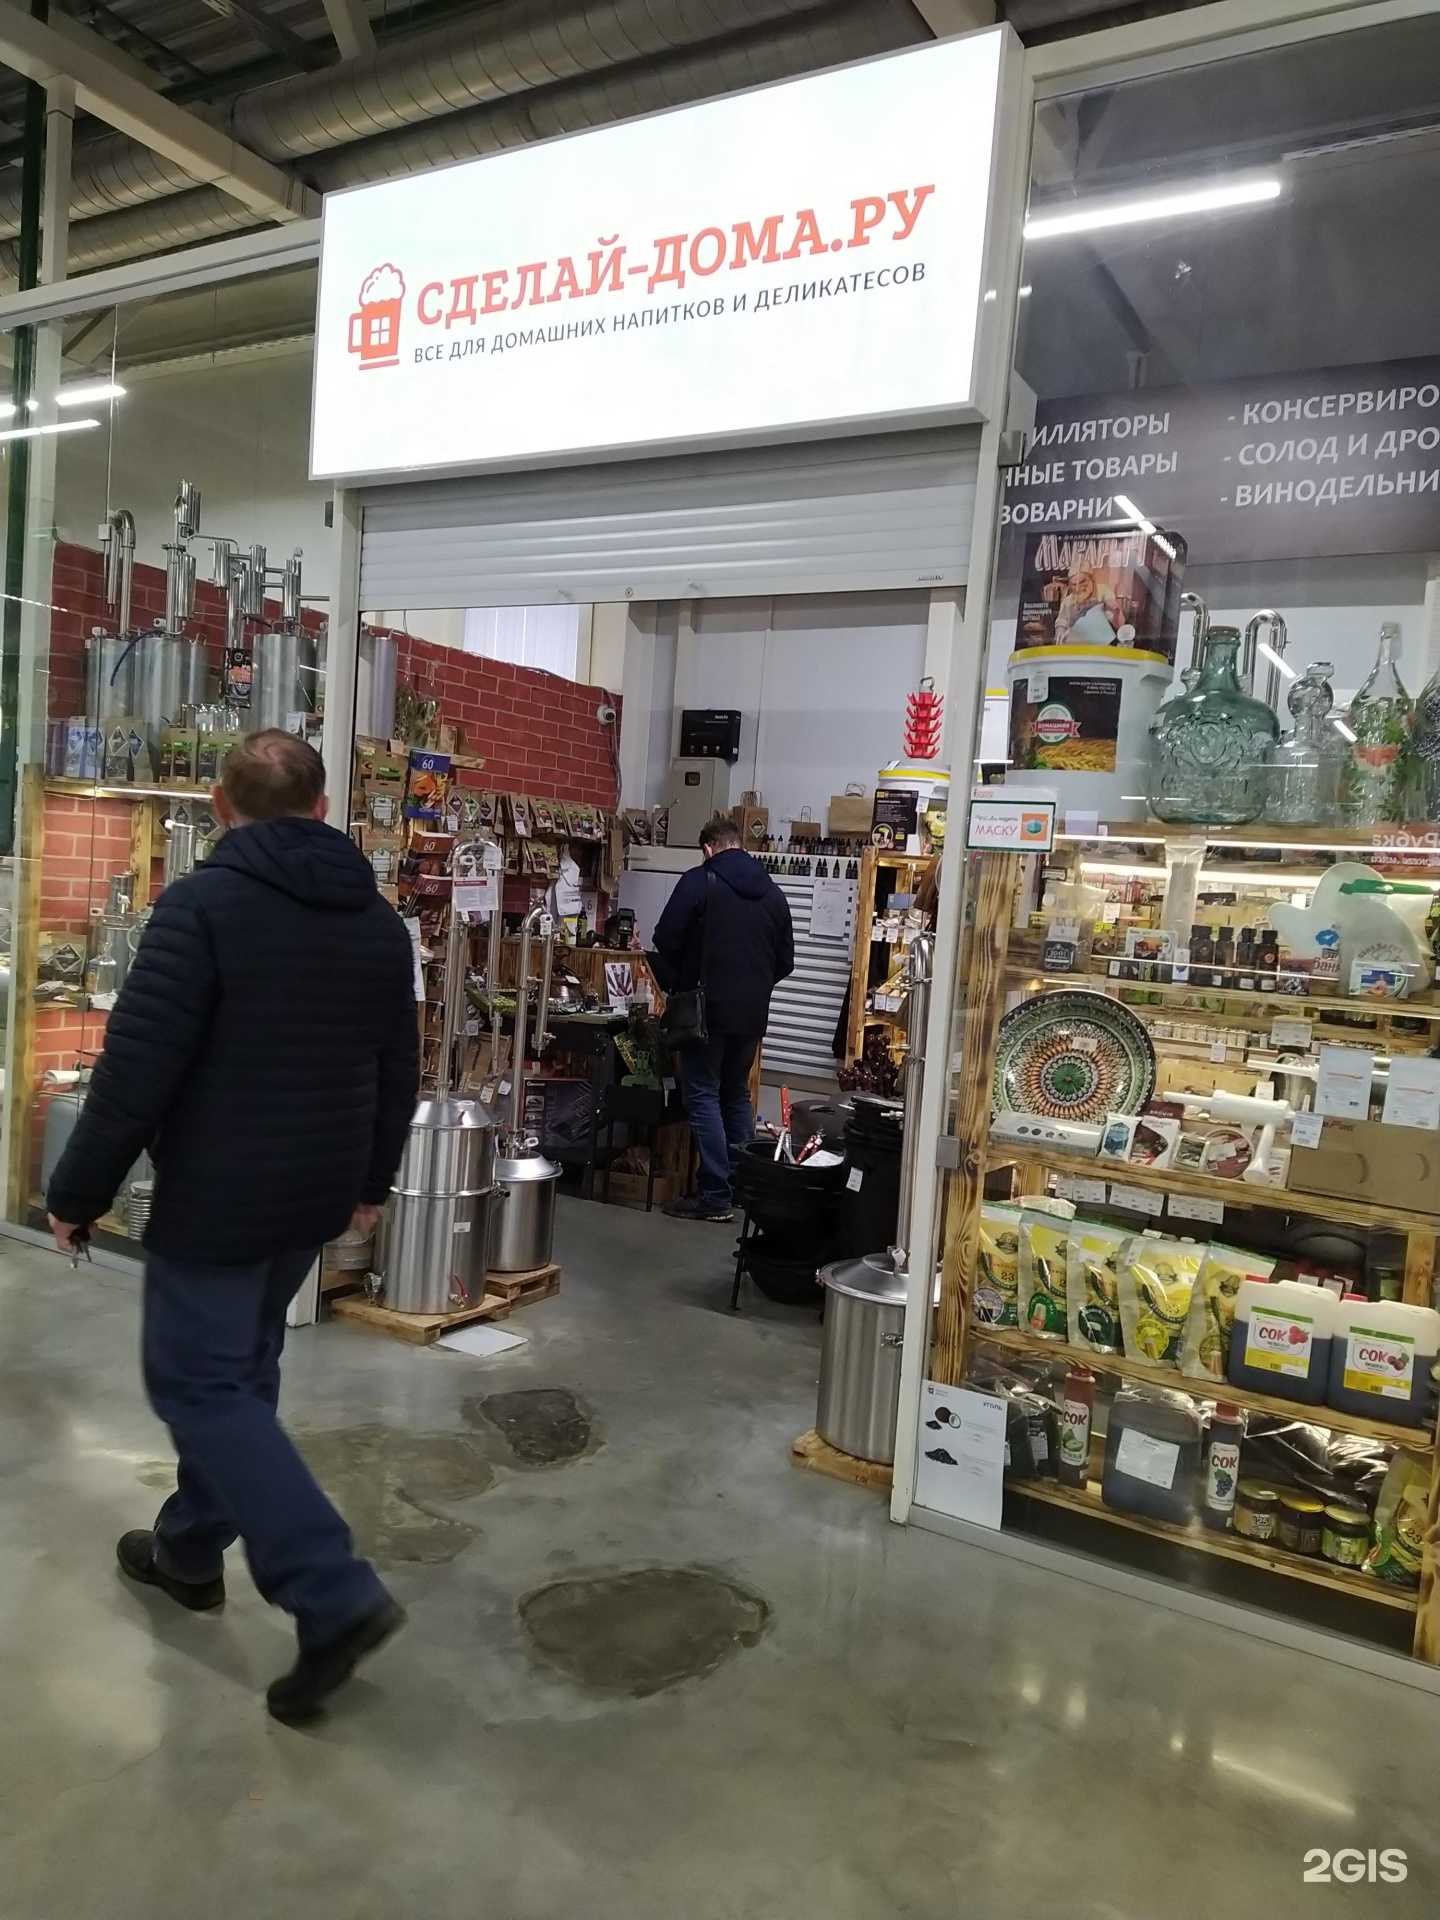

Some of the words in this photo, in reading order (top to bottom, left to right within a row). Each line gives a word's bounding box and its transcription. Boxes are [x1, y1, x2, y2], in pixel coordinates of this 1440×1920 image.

[417, 184, 935, 329] СДЕЛАЙ-ДОМА.РУ
[414, 344, 444, 363] ВСЕ
[449, 337, 485, 361] ДЛЯ
[491, 317, 605, 354] ДОМАШНИХ
[613, 297, 725, 331] НАПИТКОВ
[733, 295, 747, 312] И
[754, 262, 925, 312] ДЕЛИКАТЕСОВ
[1238, 436, 1338, 465] СОЛОД
[1347, 433, 1368, 456] И
[1072, 451, 1177, 481] ТОВАРЫ
[422, 759, 434, 769] 60
[976, 825, 1018, 836] МАСКУ
[423, 841, 435, 851] 60
[425, 882, 438, 894] 60
[1000, 1271, 1015, 1282] 23
[1259, 1326, 1287, 1341] СОК
[1359, 1348, 1388, 1362] СОК
[1063, 1410, 1088, 1426] СОК
[1211, 1454, 1237, 1469] СОК
